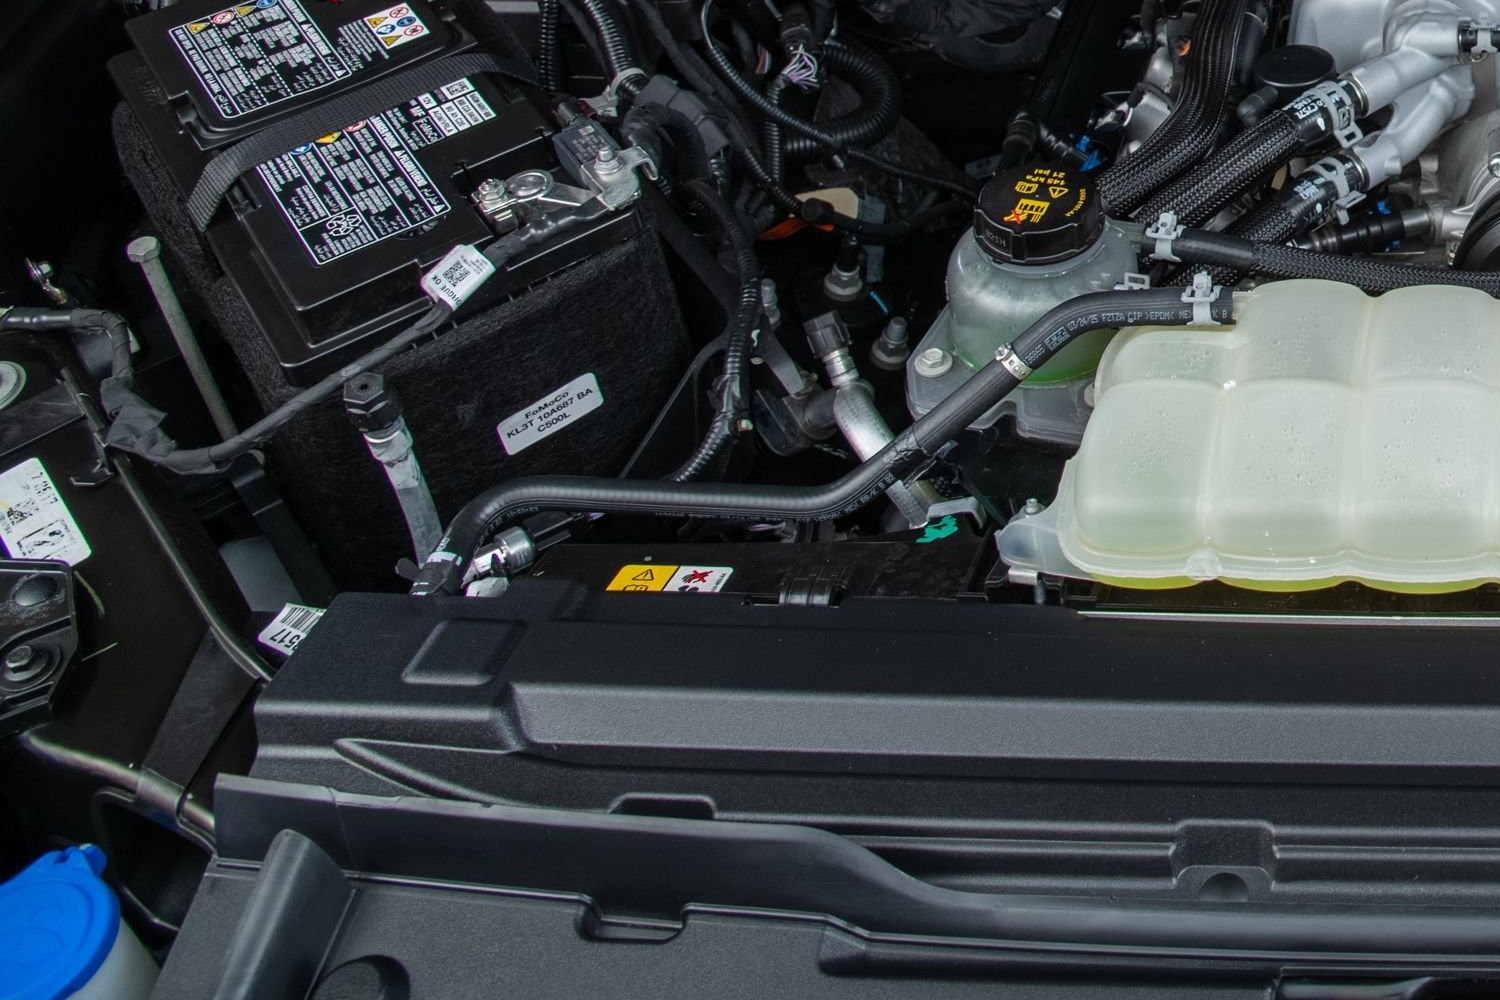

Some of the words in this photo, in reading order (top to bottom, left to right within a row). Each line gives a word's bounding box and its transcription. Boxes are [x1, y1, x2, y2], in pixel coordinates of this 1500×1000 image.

[507, 419, 535, 438] KL3T
[537, 397, 574, 421] 10A687
[576, 388, 593, 400] BA
[524, 391, 569, 419] FoMoCo
[537, 412, 571, 432] C500L
